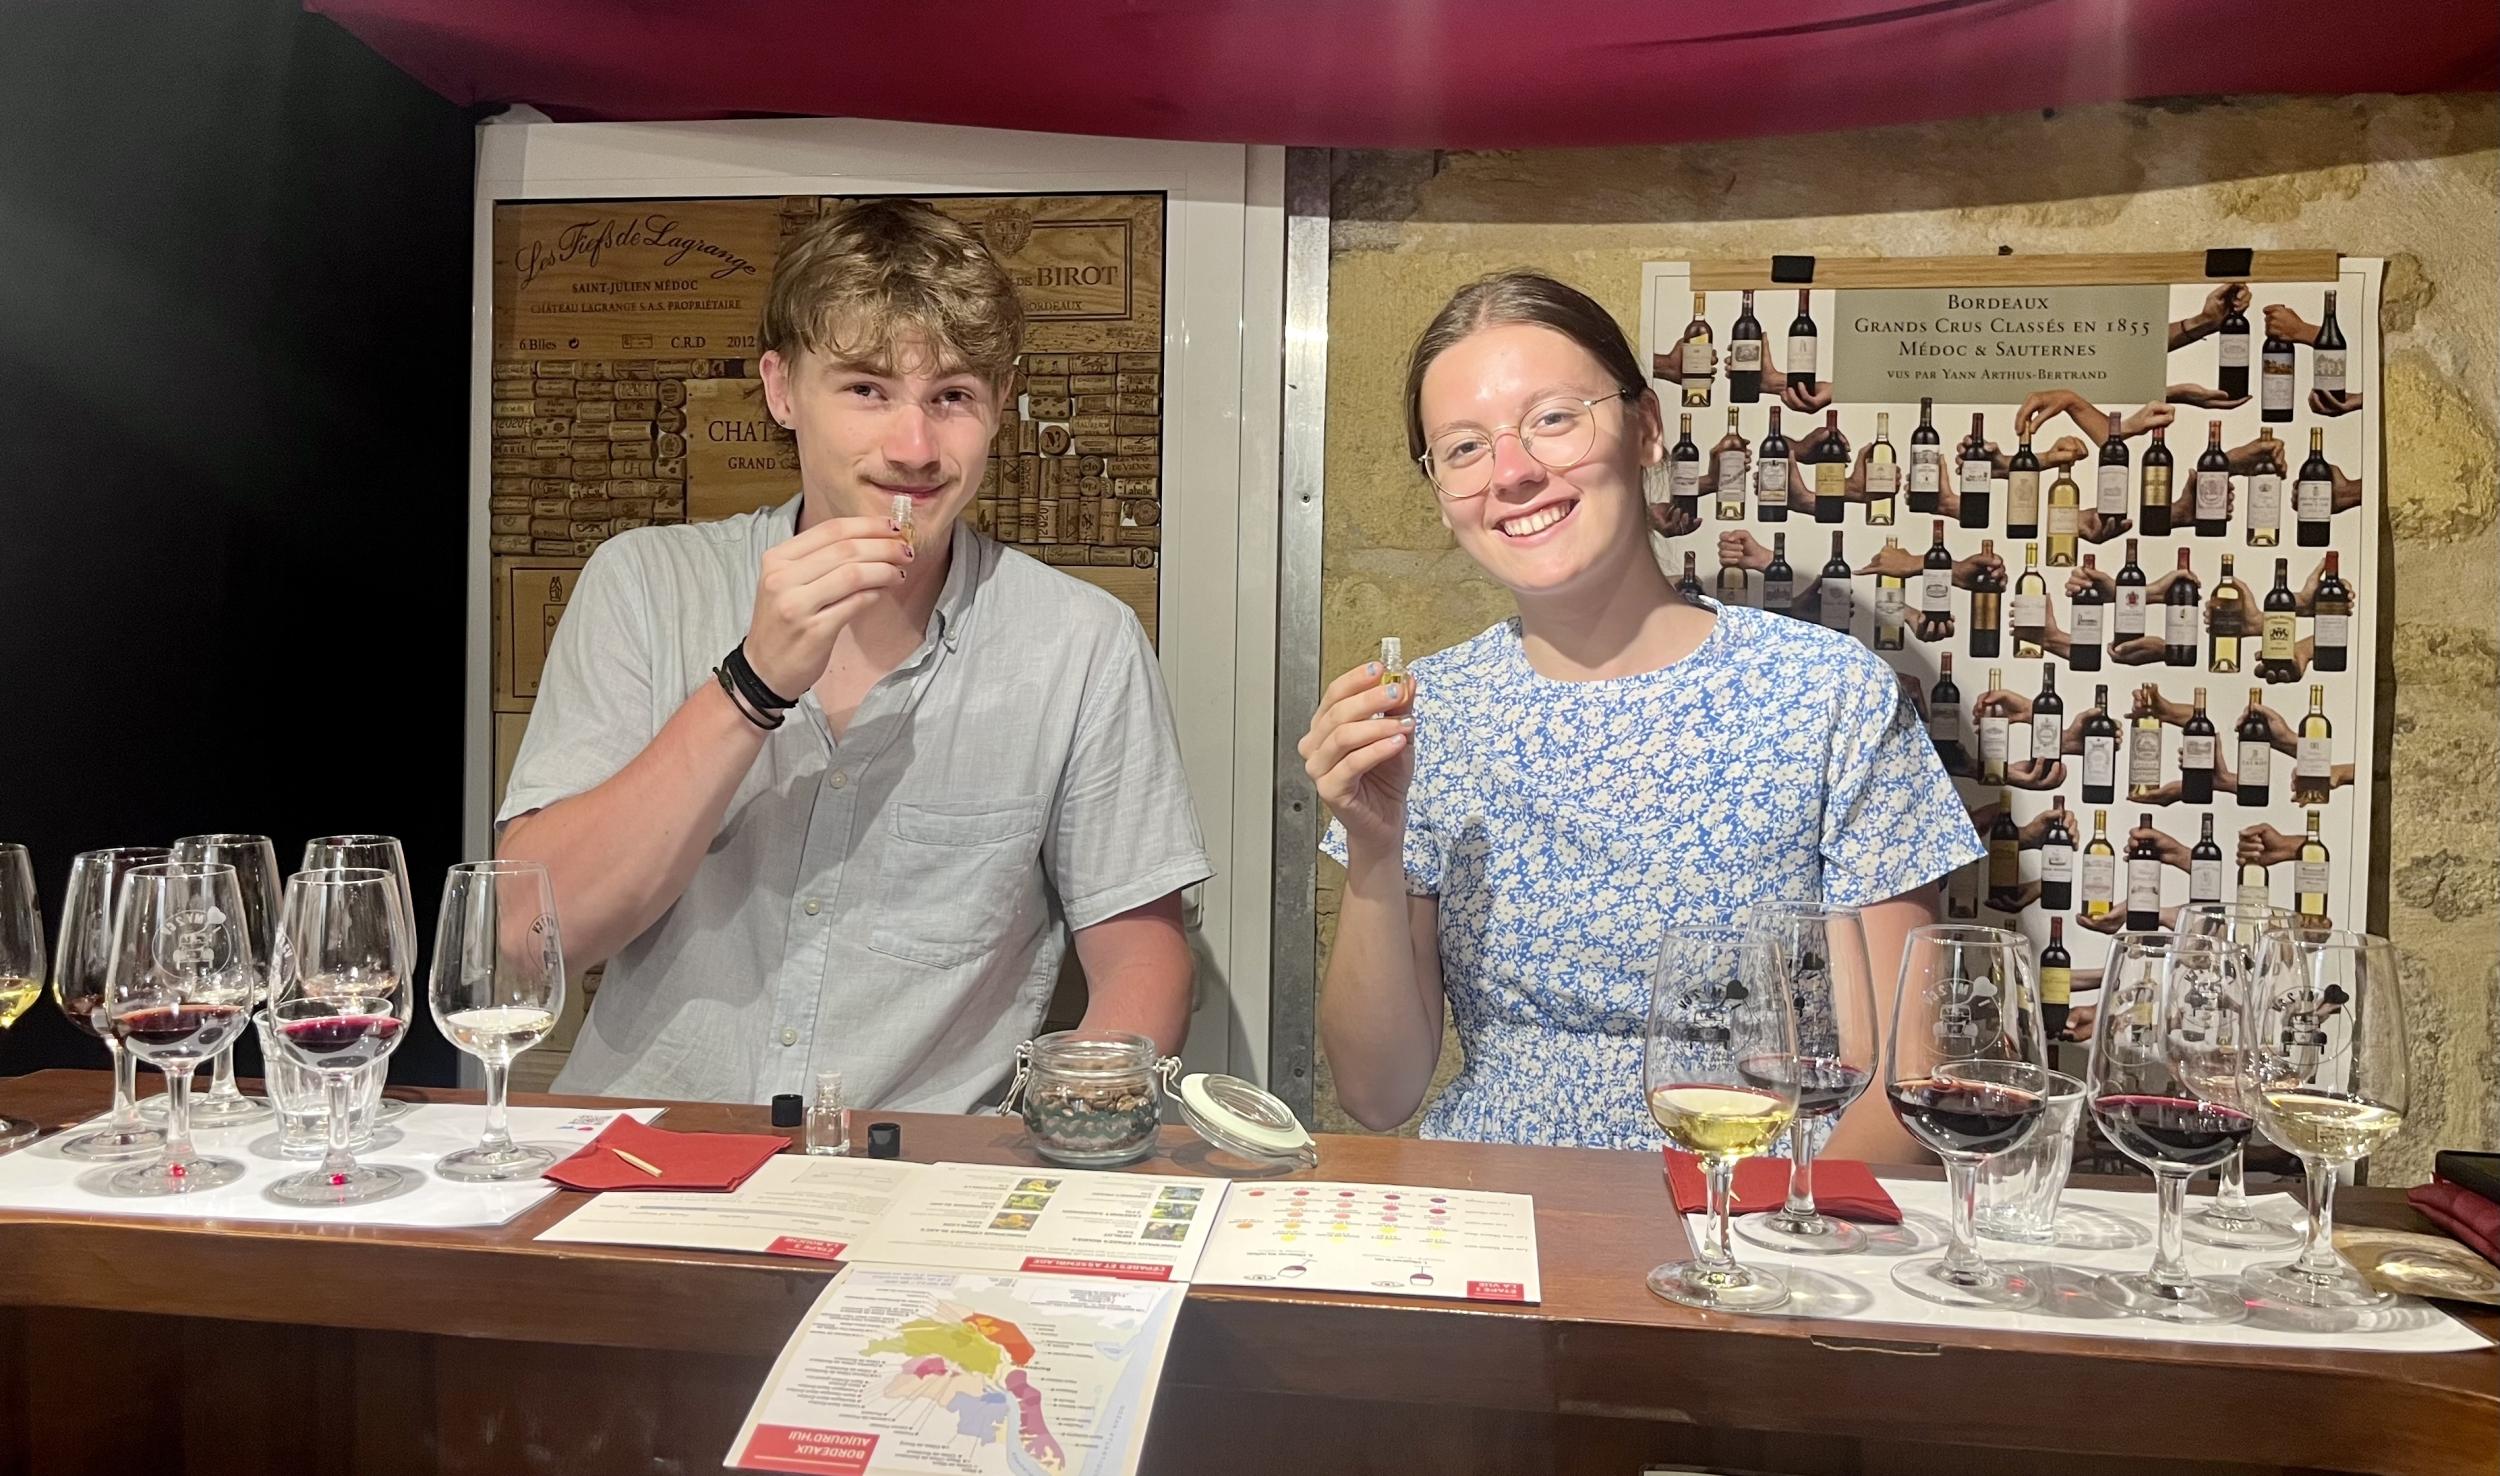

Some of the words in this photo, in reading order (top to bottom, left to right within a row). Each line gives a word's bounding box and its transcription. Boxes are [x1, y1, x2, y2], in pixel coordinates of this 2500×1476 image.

[613, 218, 642, 248] de
[643, 214, 757, 280] Lagrange
[1037, 266, 1119, 287] BIROT
[572, 281, 651, 294] SAINT-JULIEN
[654, 279, 699, 292] MÉDOC
[581, 301, 637, 313] LAGRANGE
[667, 298, 741, 311] PROPRIÉTAIRE
[1948, 294, 2049, 310] BORDEAUX
[1855, 317, 1927, 334] GRANDS
[1935, 317, 1983, 334] CRUS
[1990, 317, 2065, 333] CLASSÉS
[2073, 320, 2097, 333] EN
[2107, 319, 2151, 336] 1855
[519, 338, 526, 351] 6
[727, 335, 756, 348] 2012
[1899, 340, 1967, 357] MÉDOC
[1975, 344, 1988, 357] &
[1995, 340, 2097, 357] SAUTERNES
[1887, 369, 1910, 380] VUS
[1915, 369, 1937, 380] PAR
[1942, 367, 1976, 380] YANN
[1980, 367, 2108, 381] ARTHUS-BERTRAND
[727, 456, 776, 470] GRAND
[788, 1430, 871, 1448] AUJOURD'HUI
[793, 1443, 866, 1460] BORDEAUX
